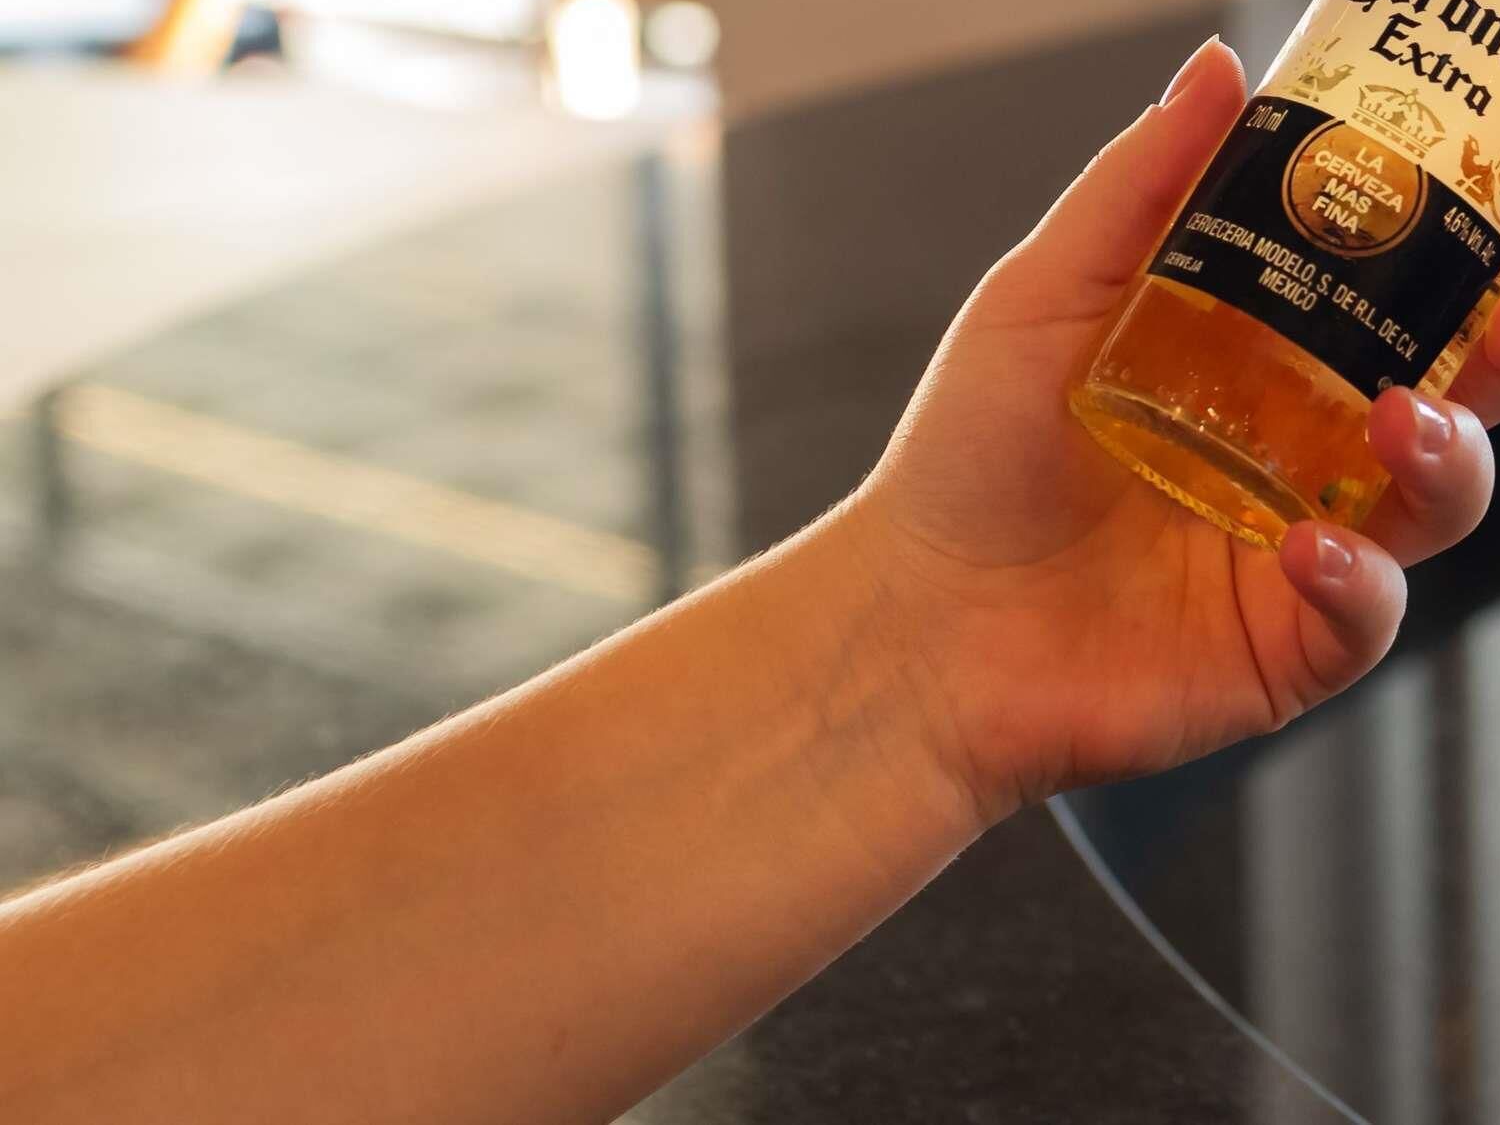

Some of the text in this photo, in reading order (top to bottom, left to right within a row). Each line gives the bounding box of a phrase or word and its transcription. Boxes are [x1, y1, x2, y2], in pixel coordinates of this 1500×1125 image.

[1369, 13, 1492, 117] Extra
[1355, 146, 1384, 174] LA
[1314, 150, 1403, 213] CERVEZA
[1324, 177, 1372, 214] MAS
[1312, 195, 1359, 234] FINA
[1443, 206, 1473, 242] 4.6%
[1163, 251, 1204, 274] CERVEJA
[1185, 212, 1256, 251] CERVECERIA
[1252, 237, 1316, 288] MODELO,
[1316, 273, 1333, 296] S.
[1331, 284, 1358, 311] DE
[1378, 318, 1401, 345] DE
[1258, 267, 1317, 311] MEXICO
